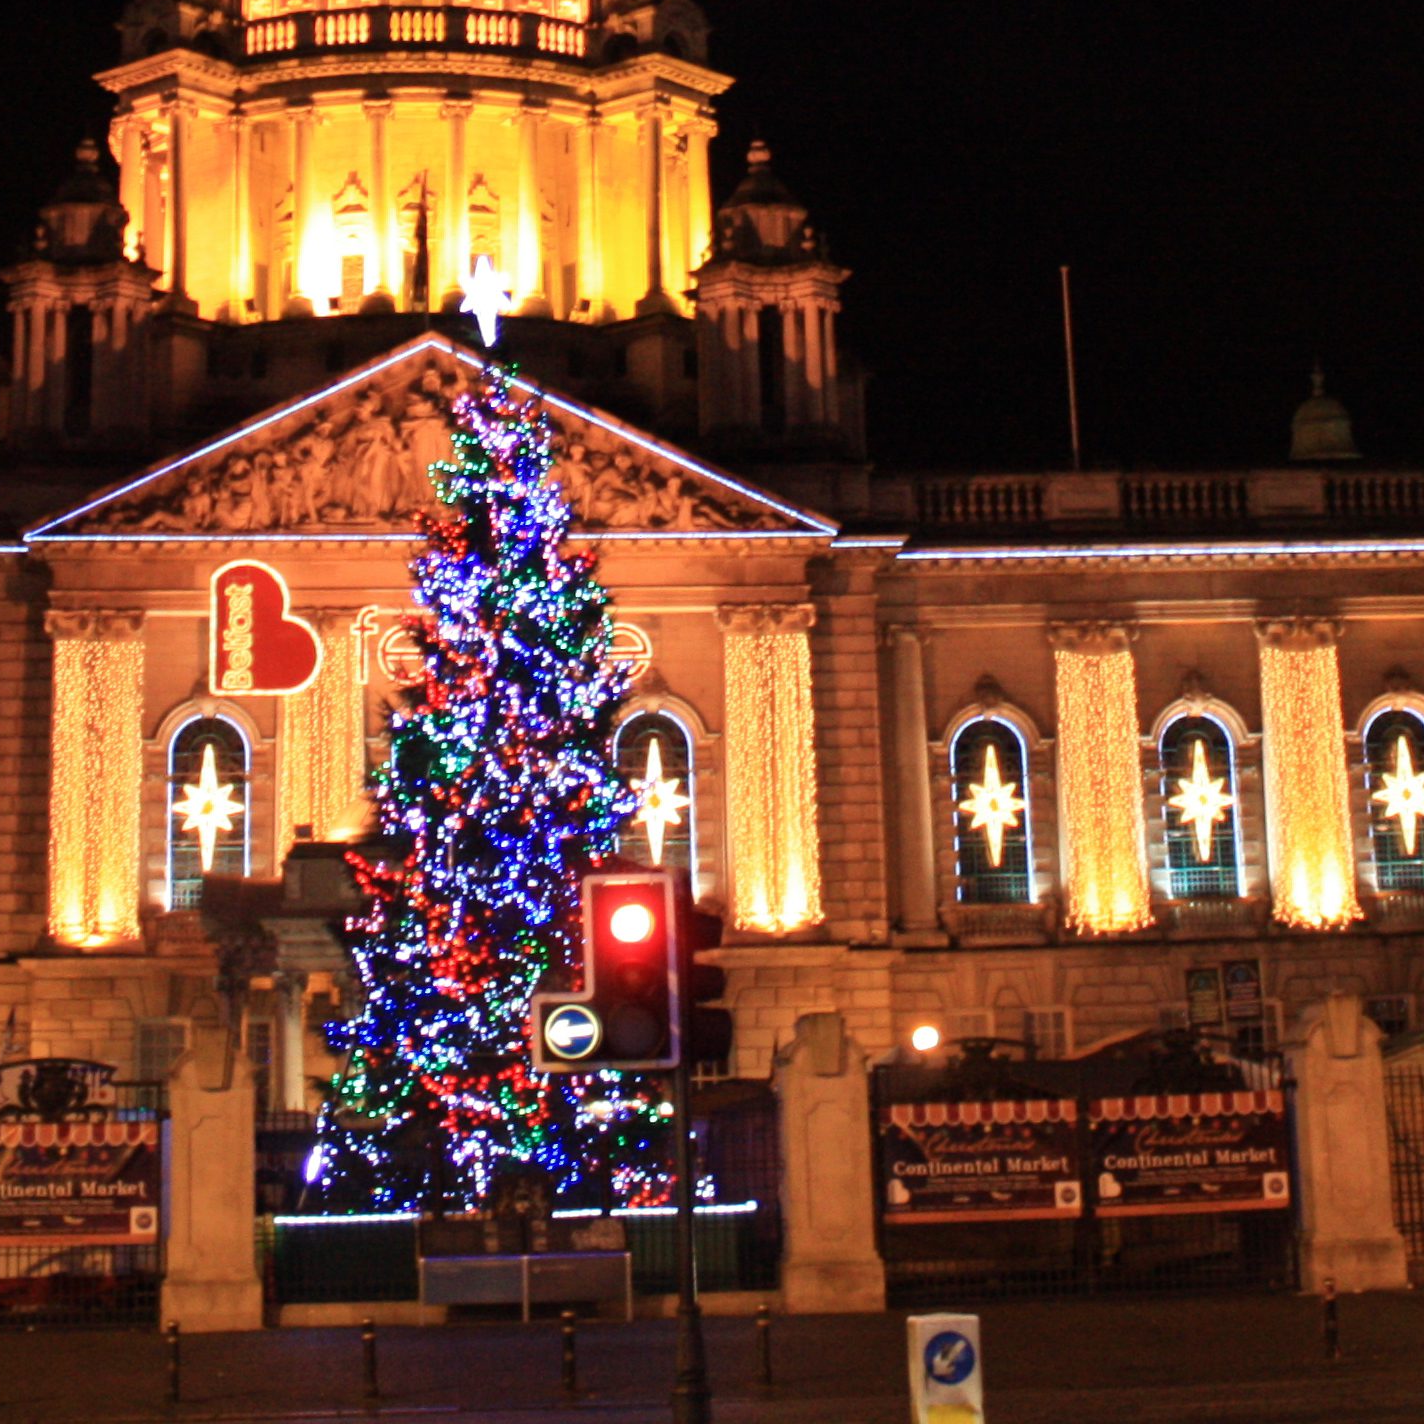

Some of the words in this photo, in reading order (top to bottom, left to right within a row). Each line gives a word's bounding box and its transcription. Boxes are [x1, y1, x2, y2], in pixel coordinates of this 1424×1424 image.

[221, 583, 254, 690] Belfast
[892, 1157, 1000, 1176] Continental
[1007, 1155, 1070, 1173] Market
[1104, 1150, 1208, 1170] Continental
[1215, 1147, 1276, 1164] Market
[81, 1179, 147, 1198] Market
